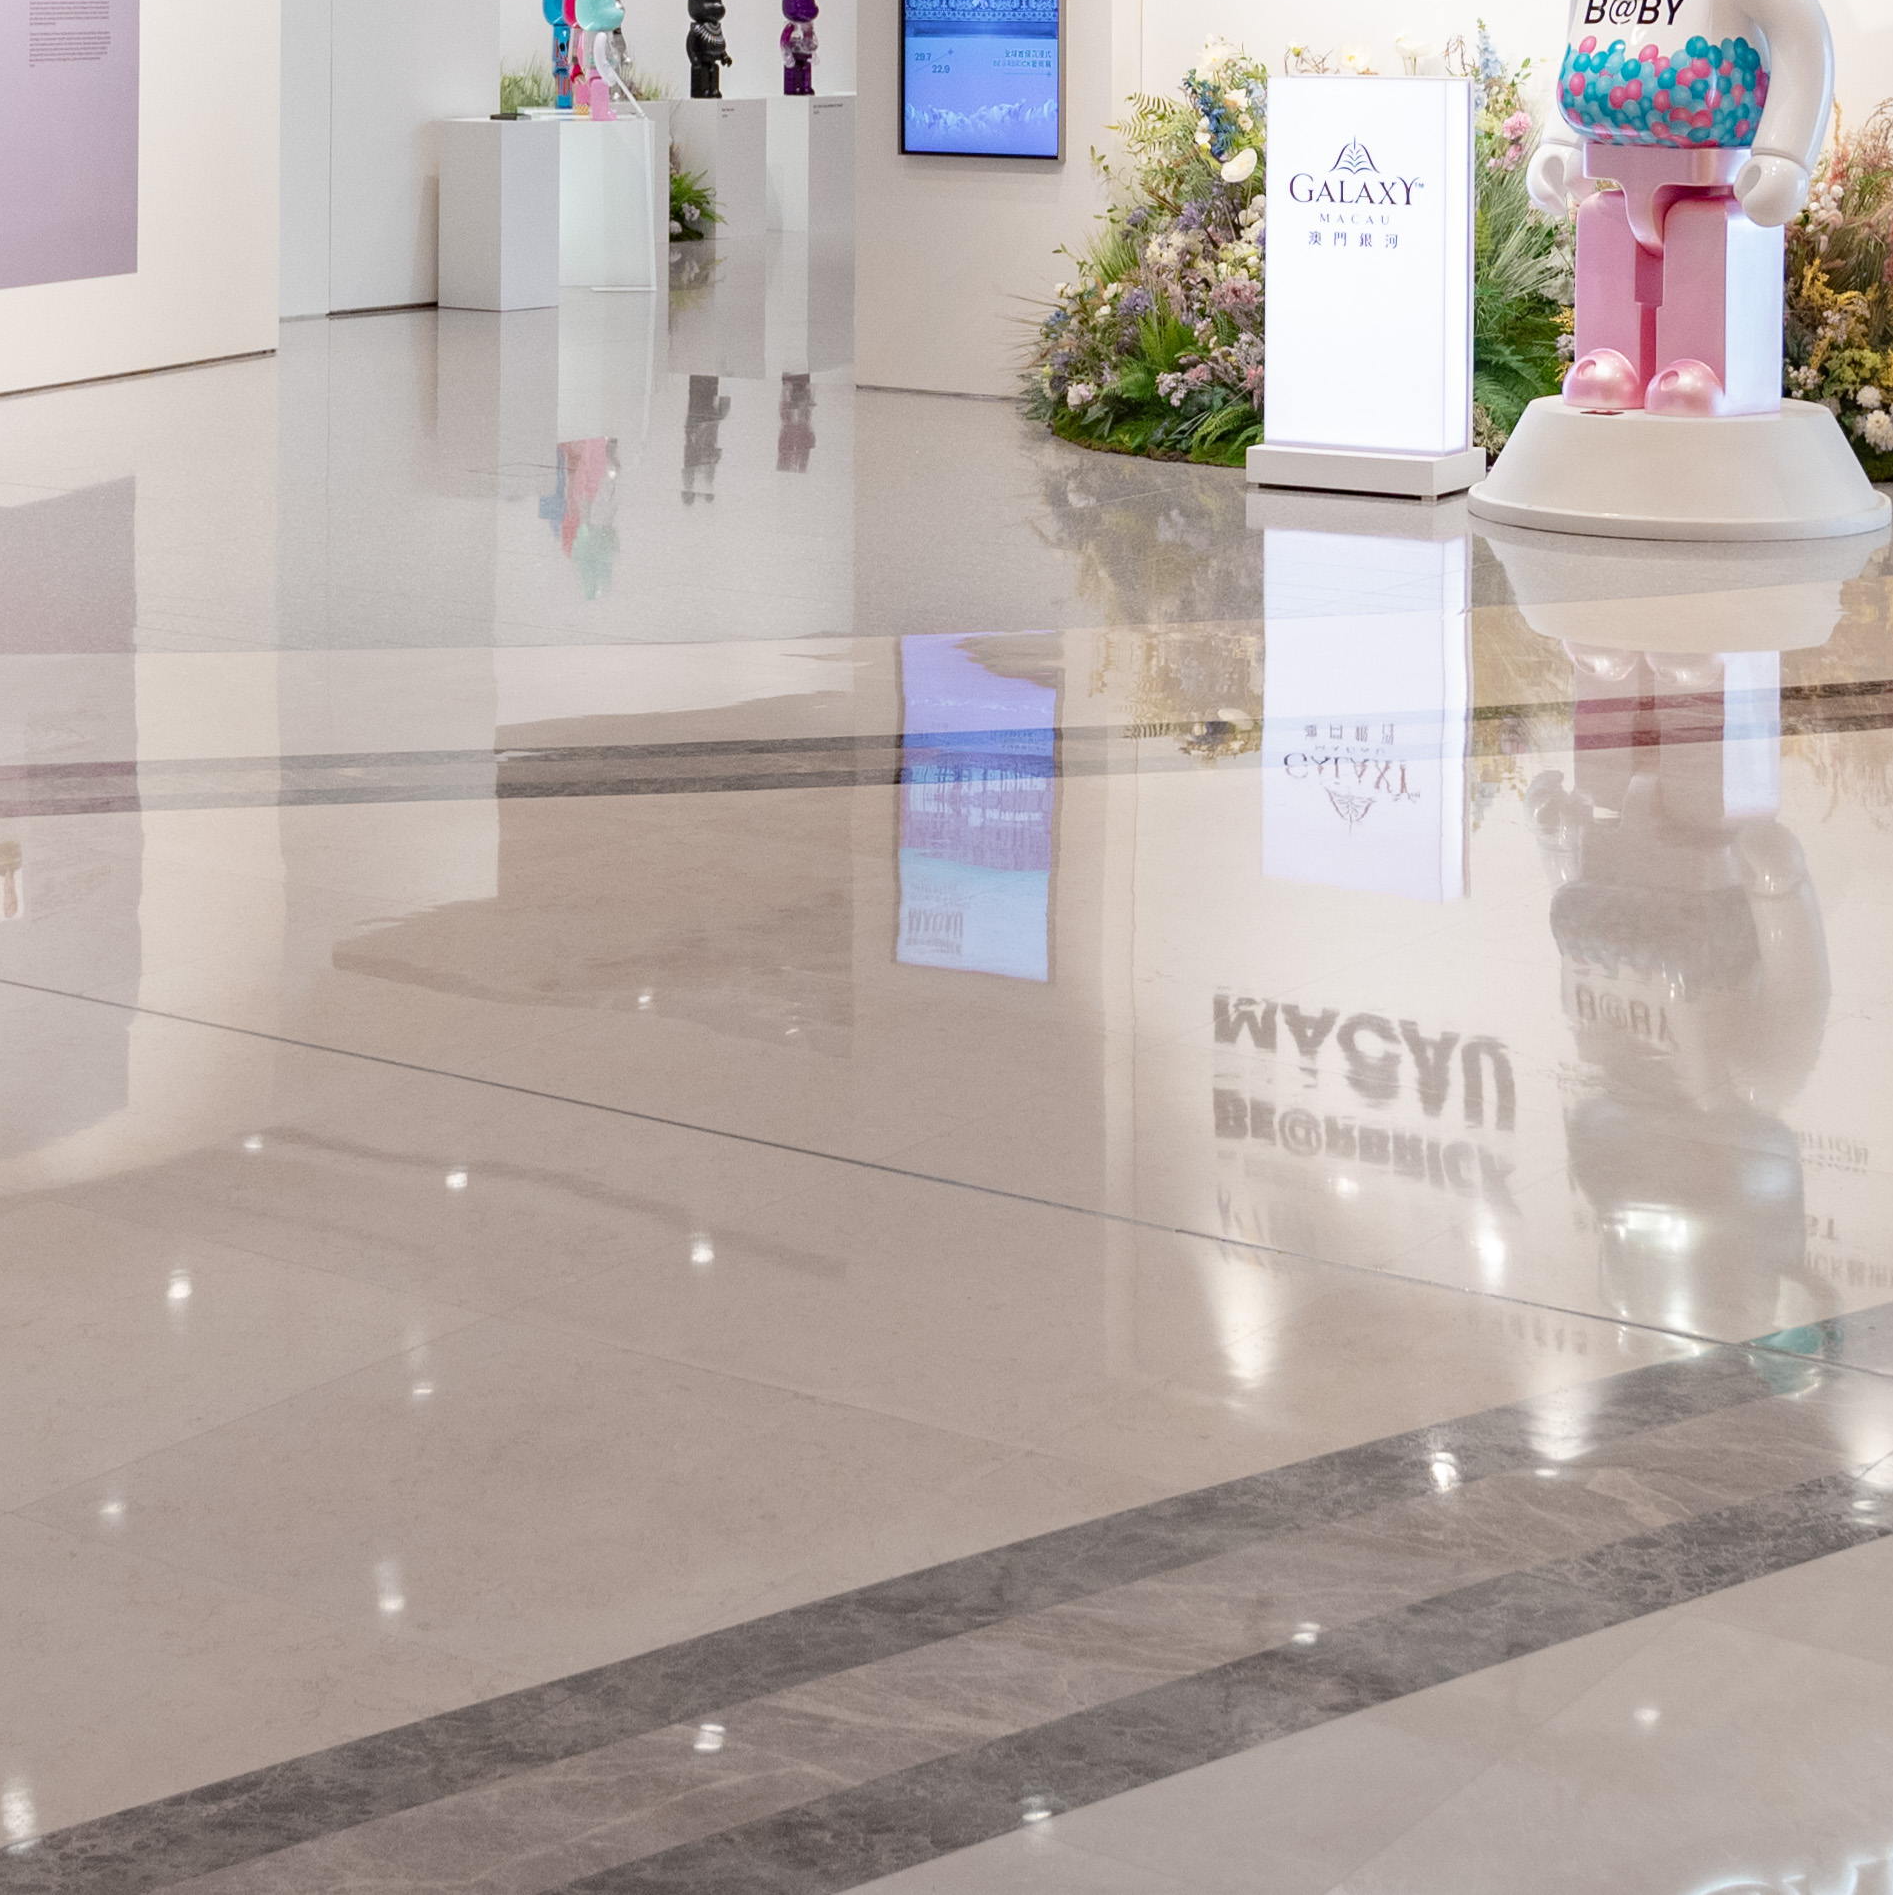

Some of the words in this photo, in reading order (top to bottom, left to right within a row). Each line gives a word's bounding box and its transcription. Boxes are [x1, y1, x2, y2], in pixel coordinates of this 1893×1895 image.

[932, 65, 950, 73] 22.9
[1320, 213, 1390, 225] MACAU
[1309, 231, 1398, 249] 澳門銀河
